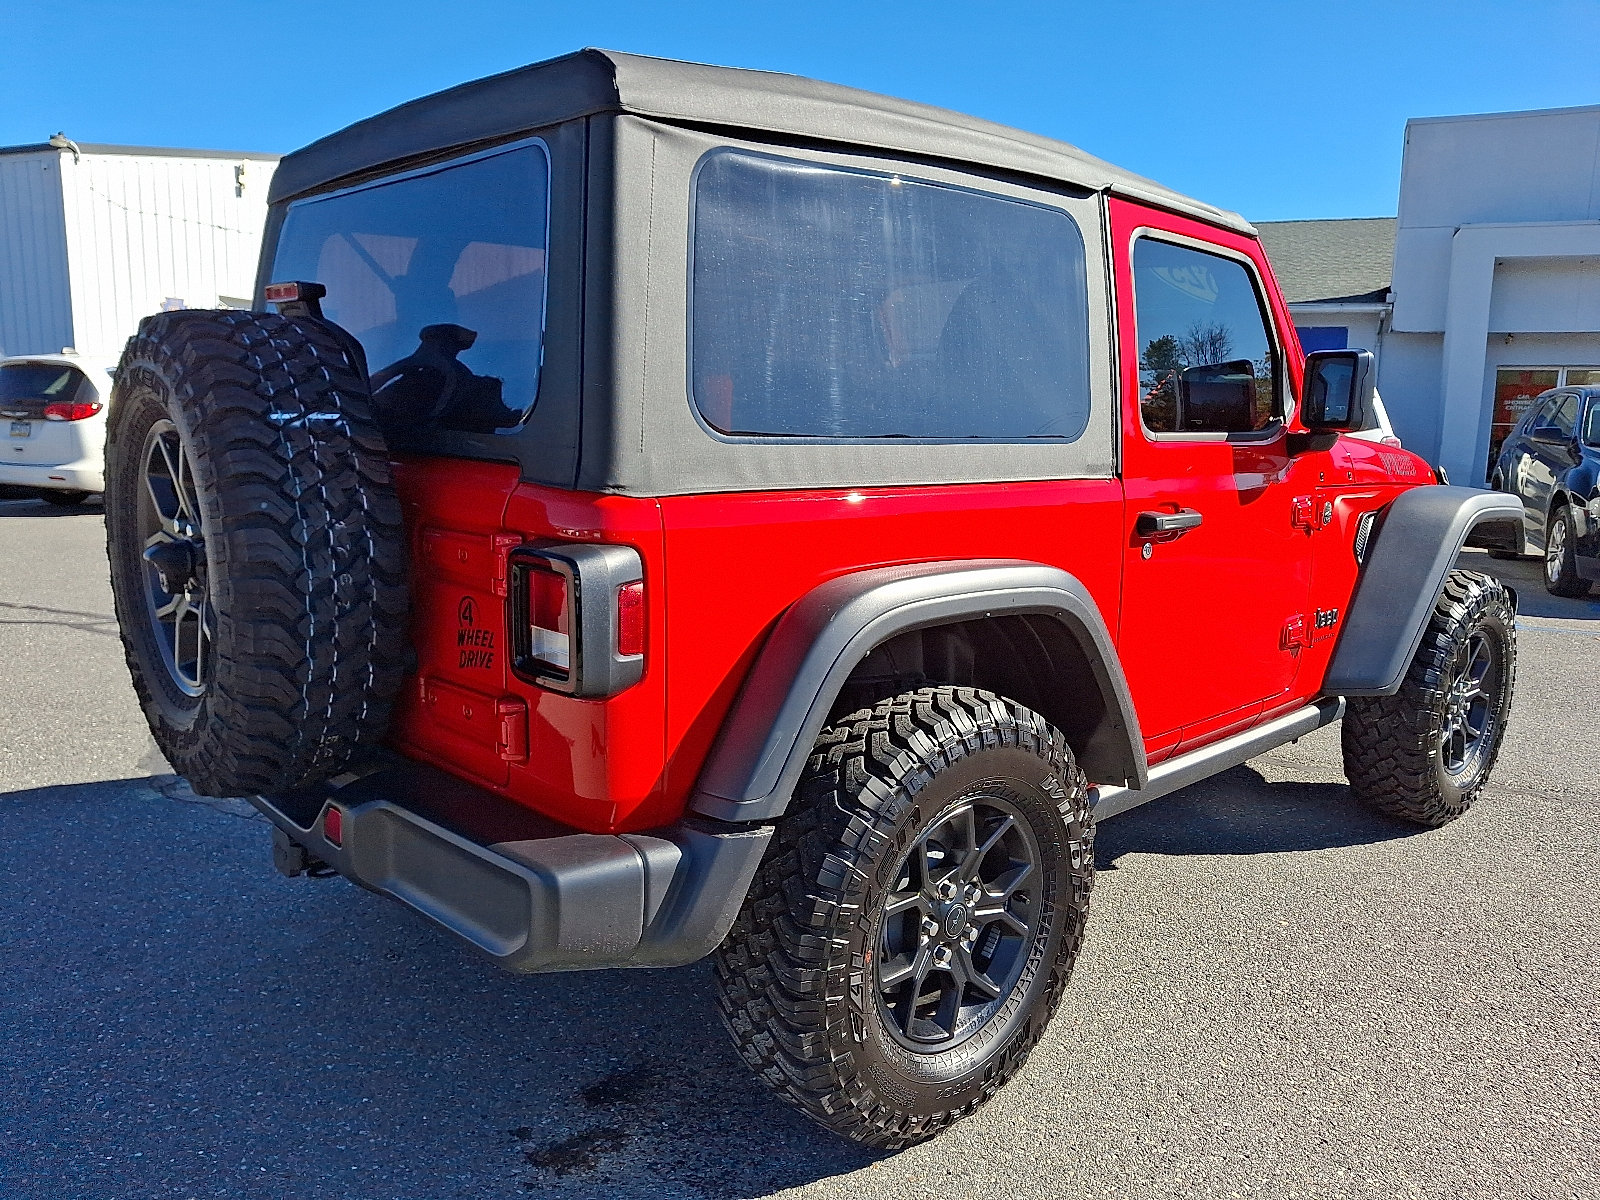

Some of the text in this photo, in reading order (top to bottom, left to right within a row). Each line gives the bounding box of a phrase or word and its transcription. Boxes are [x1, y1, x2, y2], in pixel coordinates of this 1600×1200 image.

[462, 601, 473, 626] 4
[1314, 607, 1339, 629] Jeep
[457, 629, 494, 648] WHEEL
[459, 649, 494, 669] DRIVE
